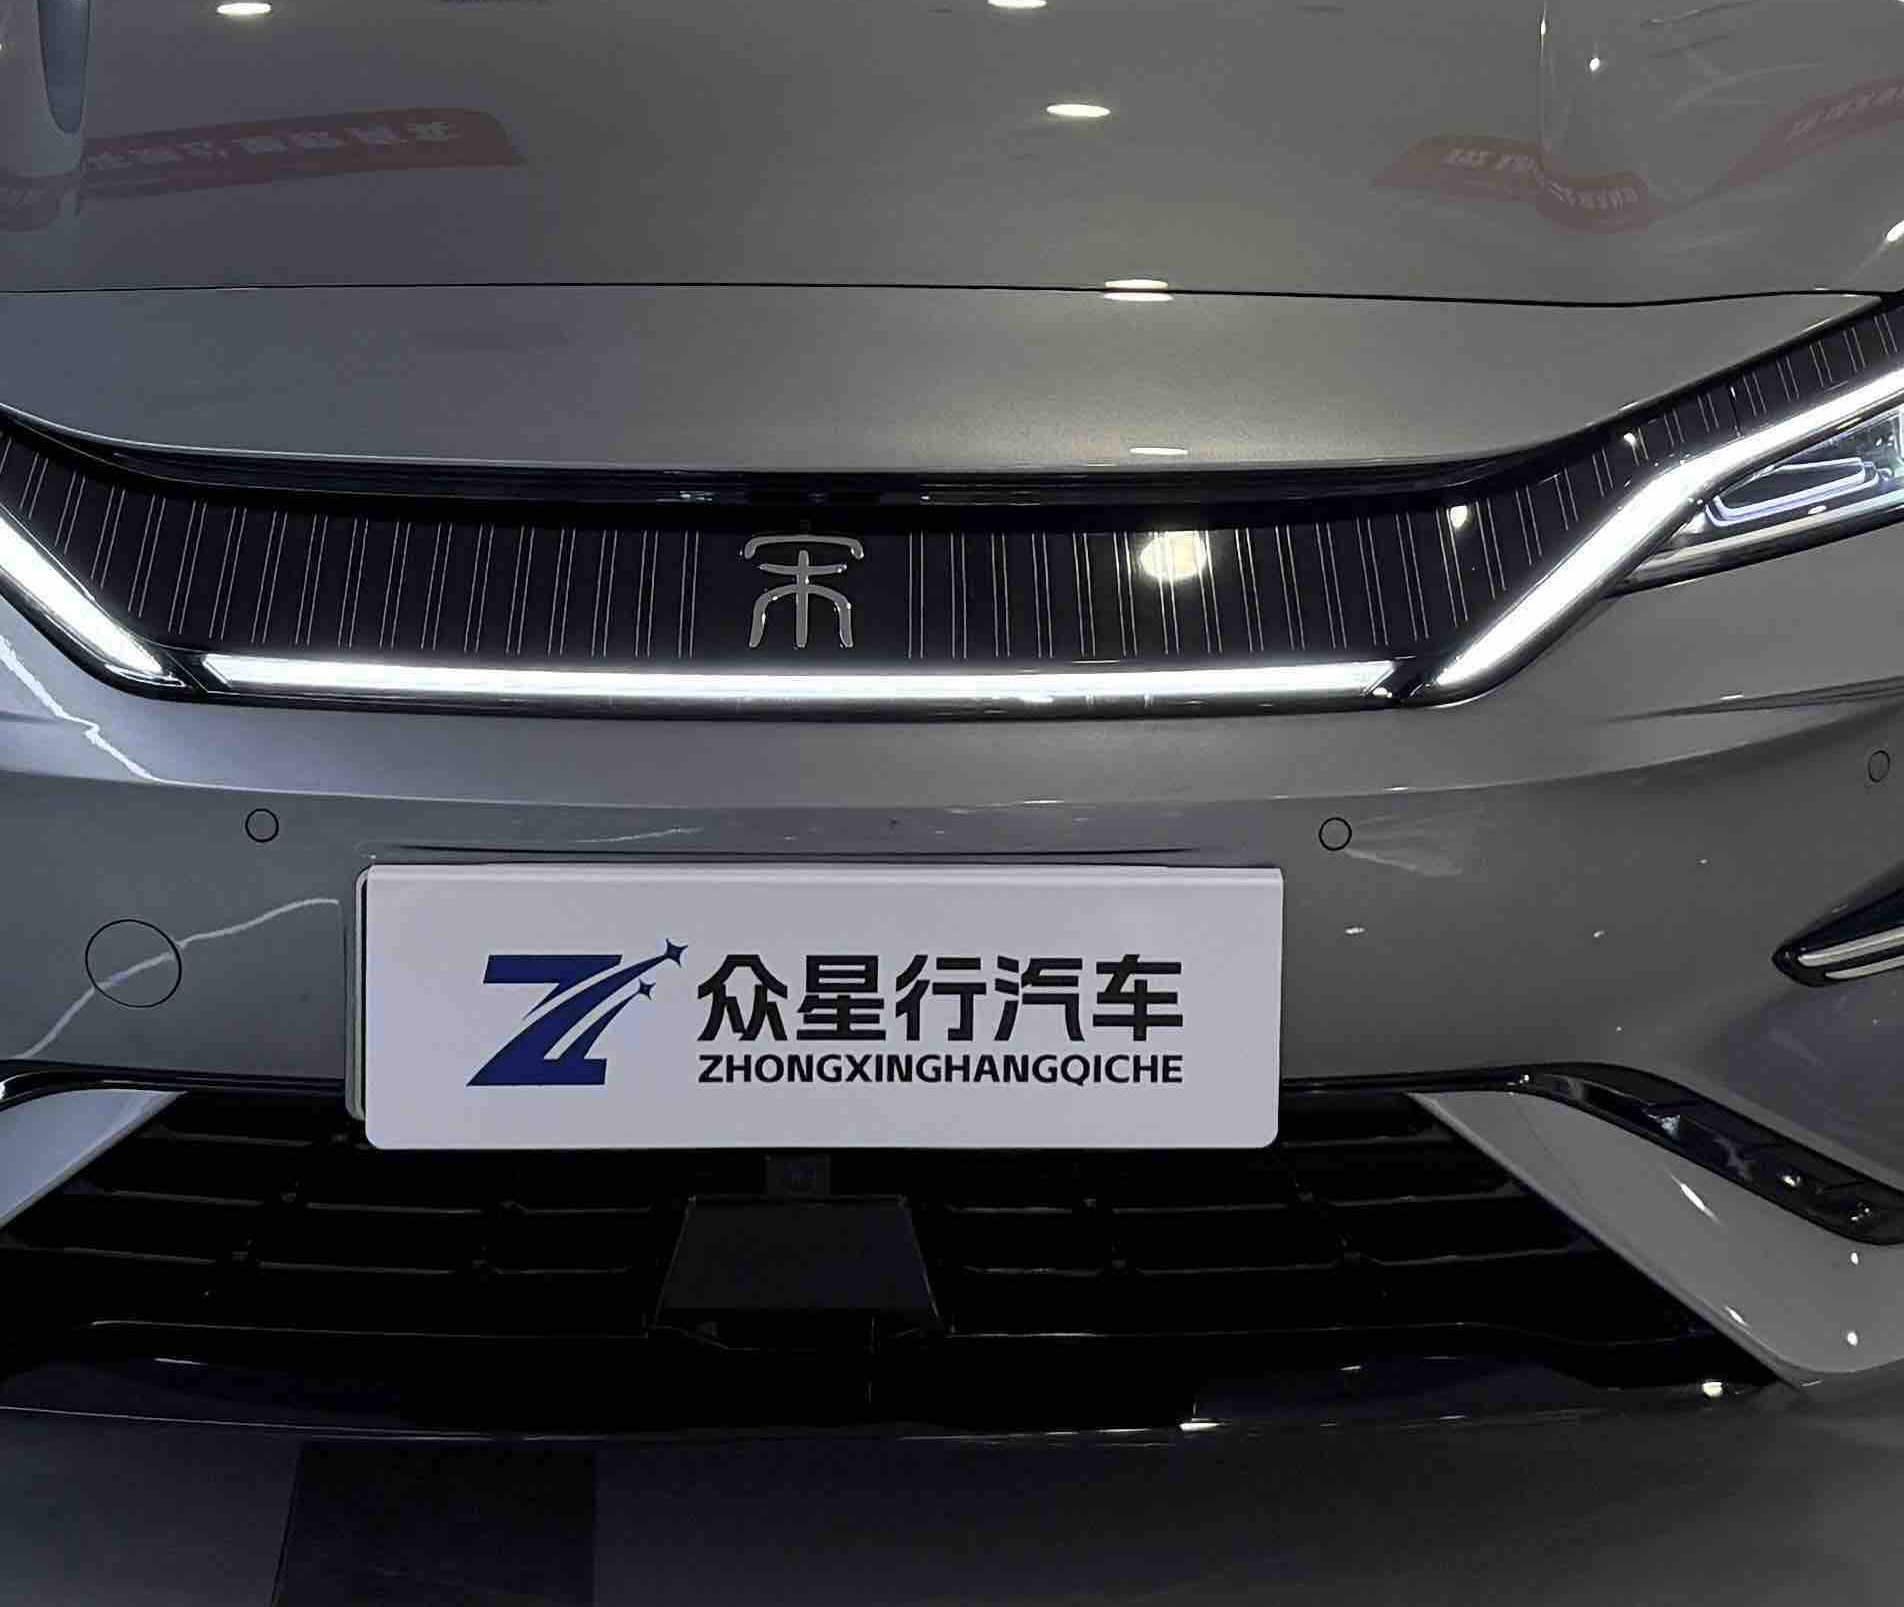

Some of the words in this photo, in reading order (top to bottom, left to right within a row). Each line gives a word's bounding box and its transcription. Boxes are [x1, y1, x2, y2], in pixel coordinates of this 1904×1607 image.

[696, 952, 1185, 1043] 众星行汽车
[697, 1052, 1185, 1087] ZHONGXINGHANGQICHE
